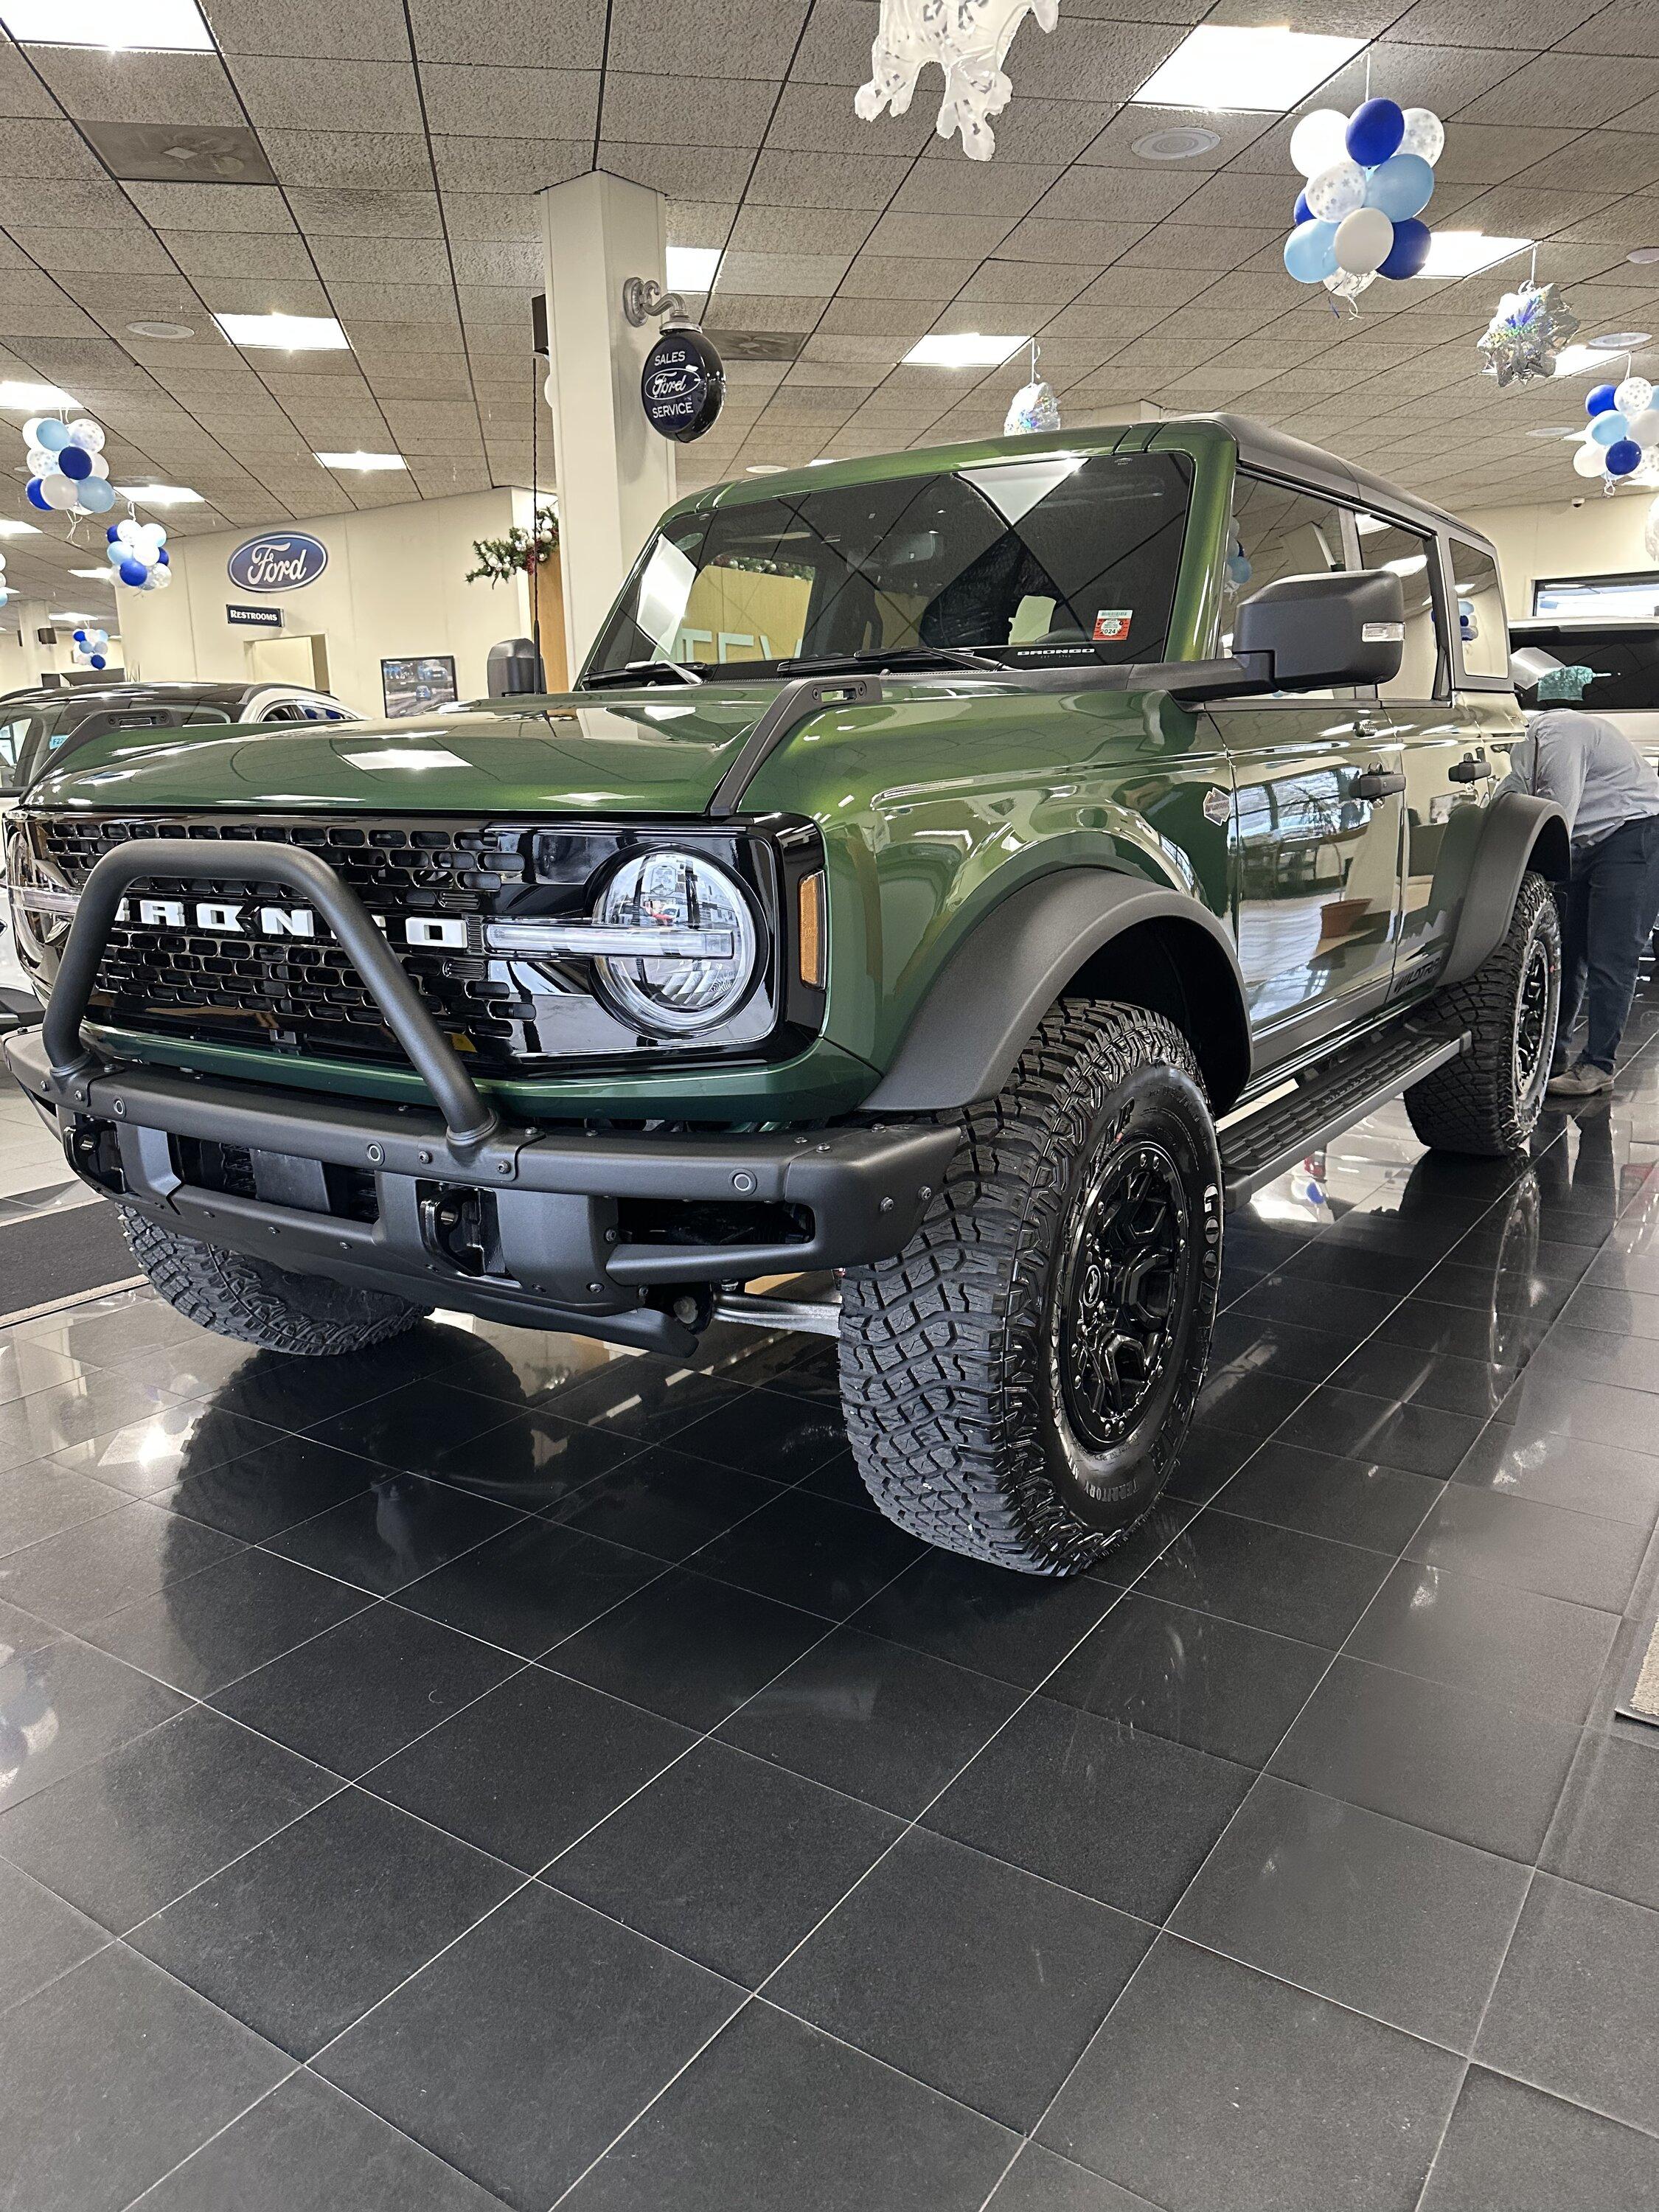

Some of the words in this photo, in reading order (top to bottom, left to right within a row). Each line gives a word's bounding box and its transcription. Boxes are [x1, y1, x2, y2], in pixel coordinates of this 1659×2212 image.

[654, 350, 686, 366] SALES
[652, 371, 687, 396] Ford
[652, 402, 694, 419] SERVICE
[247, 542, 307, 585] Ford
[1017, 648, 1096, 656] BRONCO
[114, 897, 468, 950] RONO
[1083, 1478, 1138, 1503] TERRITORY
